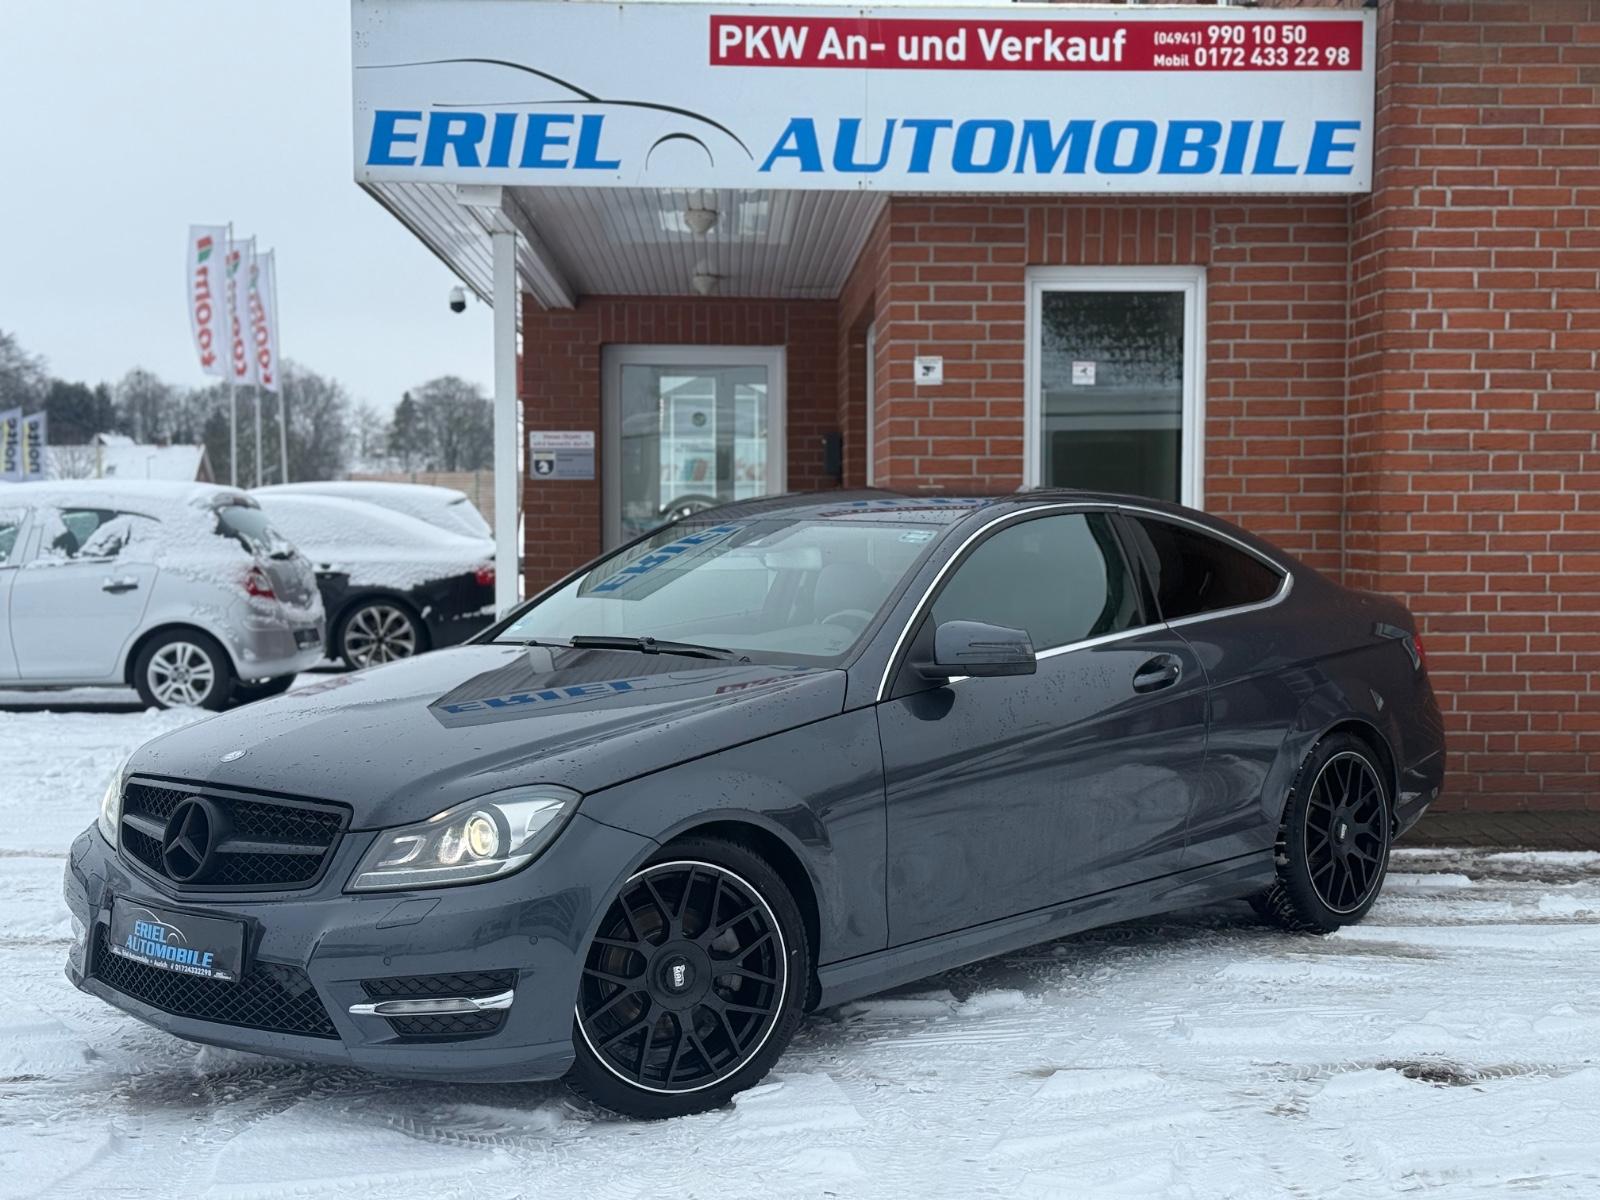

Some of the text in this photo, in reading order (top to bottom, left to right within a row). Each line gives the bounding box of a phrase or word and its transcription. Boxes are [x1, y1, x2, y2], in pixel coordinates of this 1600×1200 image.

[719, 24, 1127, 63] PKW An- und Verkauf
[1153, 25, 1307, 45] (04941) 990 10 50
[1153, 47, 1350, 67] Mobil 0172 433 22 98
[366, 110, 1361, 175] ERIEL AUTOMOBILE
[134, 920, 167, 943] ERIEL
[124, 934, 215, 968] AUTOMOBILE
